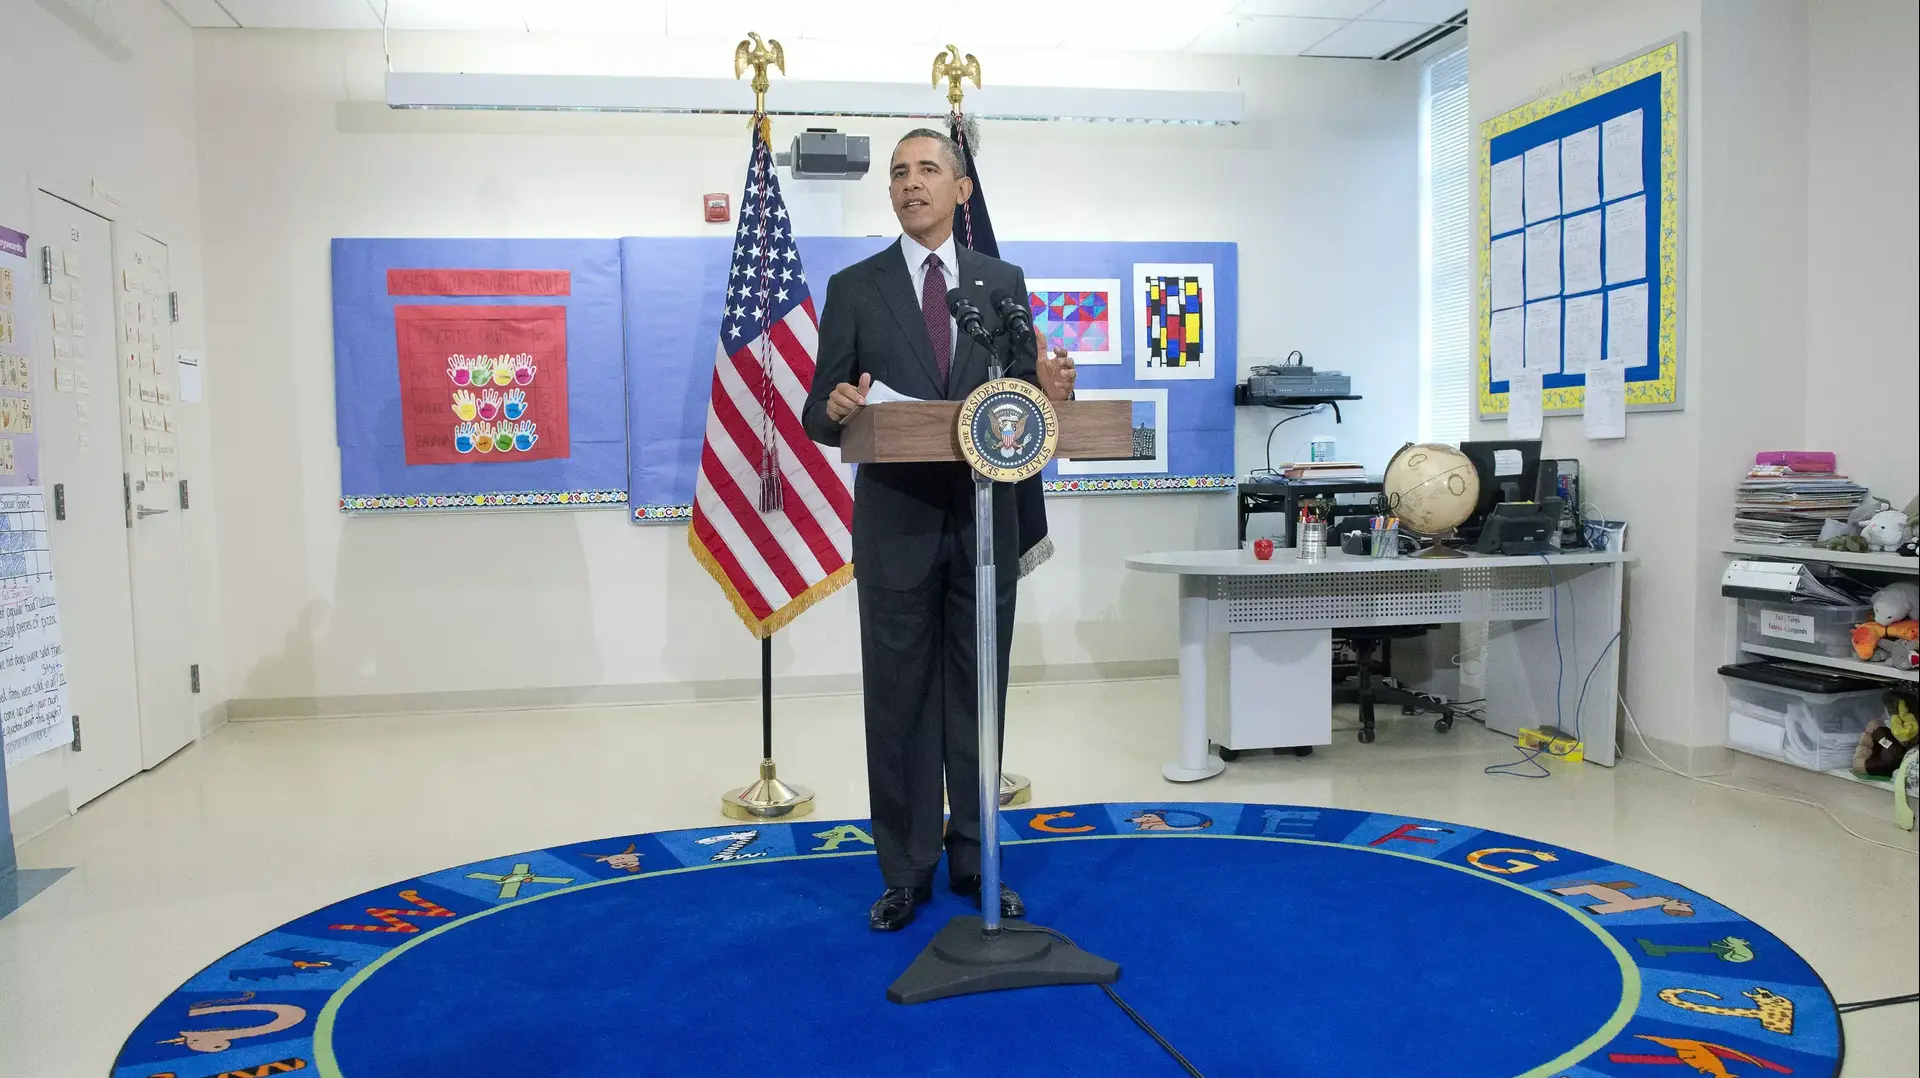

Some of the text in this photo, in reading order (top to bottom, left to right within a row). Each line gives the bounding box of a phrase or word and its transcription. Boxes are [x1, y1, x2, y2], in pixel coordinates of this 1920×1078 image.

[962, 381, 1056, 477] SEAL OF THE PRESIDENT OF THE UNITED STATES
[36, 574, 40, 583] 5
[1788, 615, 1800, 623] Tales
[40, 644, 50, 658] sold
[33, 678, 44, 693] sold
[4, 710, 15, 721] come
[48, 695, 58, 706] own
[1028, 810, 1096, 833] C
[1466, 847, 1560, 874] G
[465, 863, 575, 899] X
